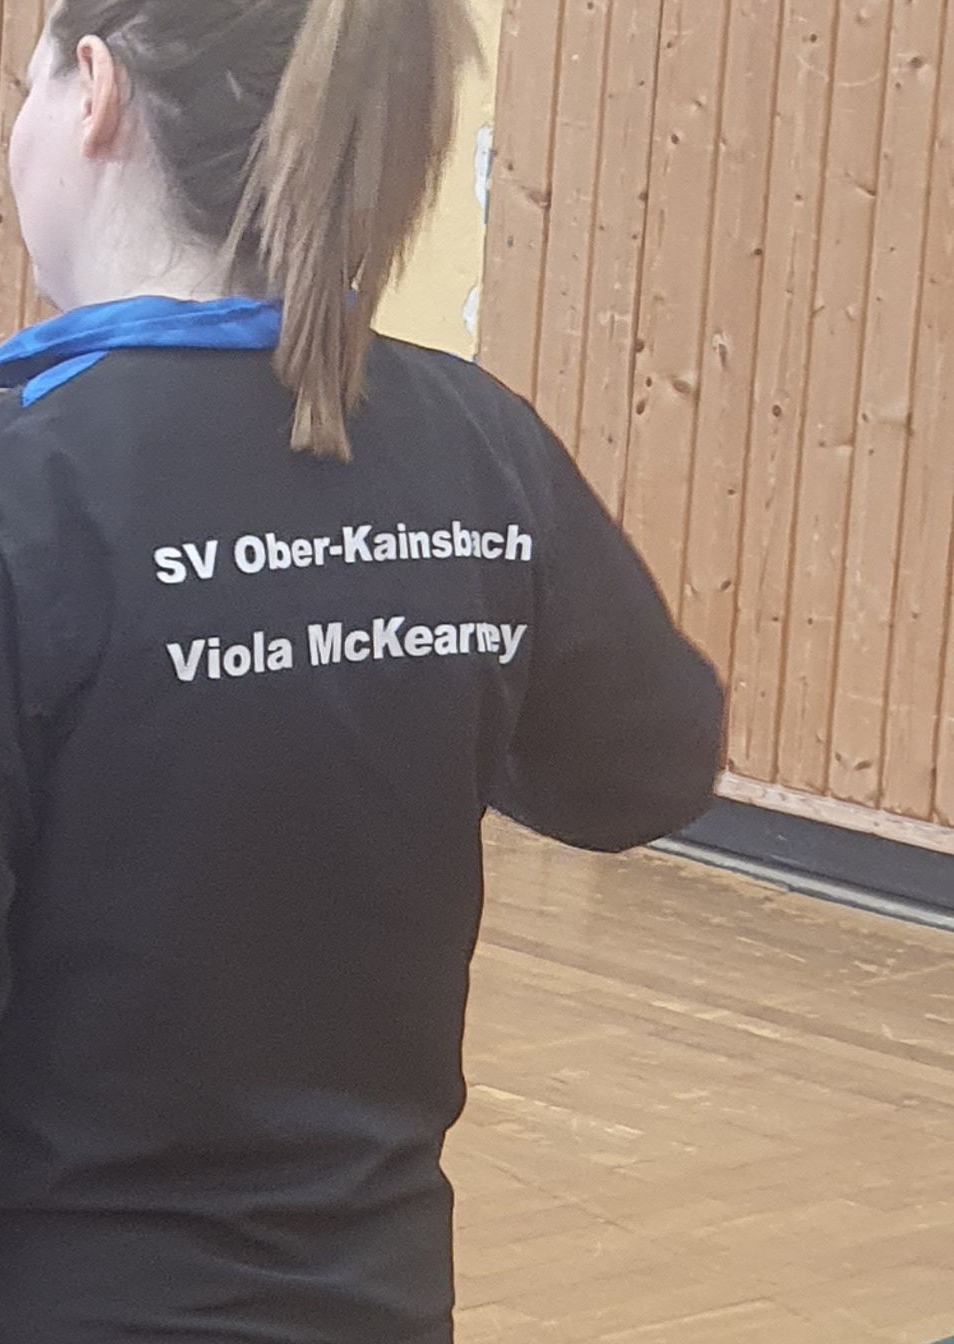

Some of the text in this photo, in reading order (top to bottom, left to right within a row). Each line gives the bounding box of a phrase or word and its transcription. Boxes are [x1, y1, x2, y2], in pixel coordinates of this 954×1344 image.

[153, 539, 219, 584] SV
[165, 615, 528, 683] Viola McKearney
